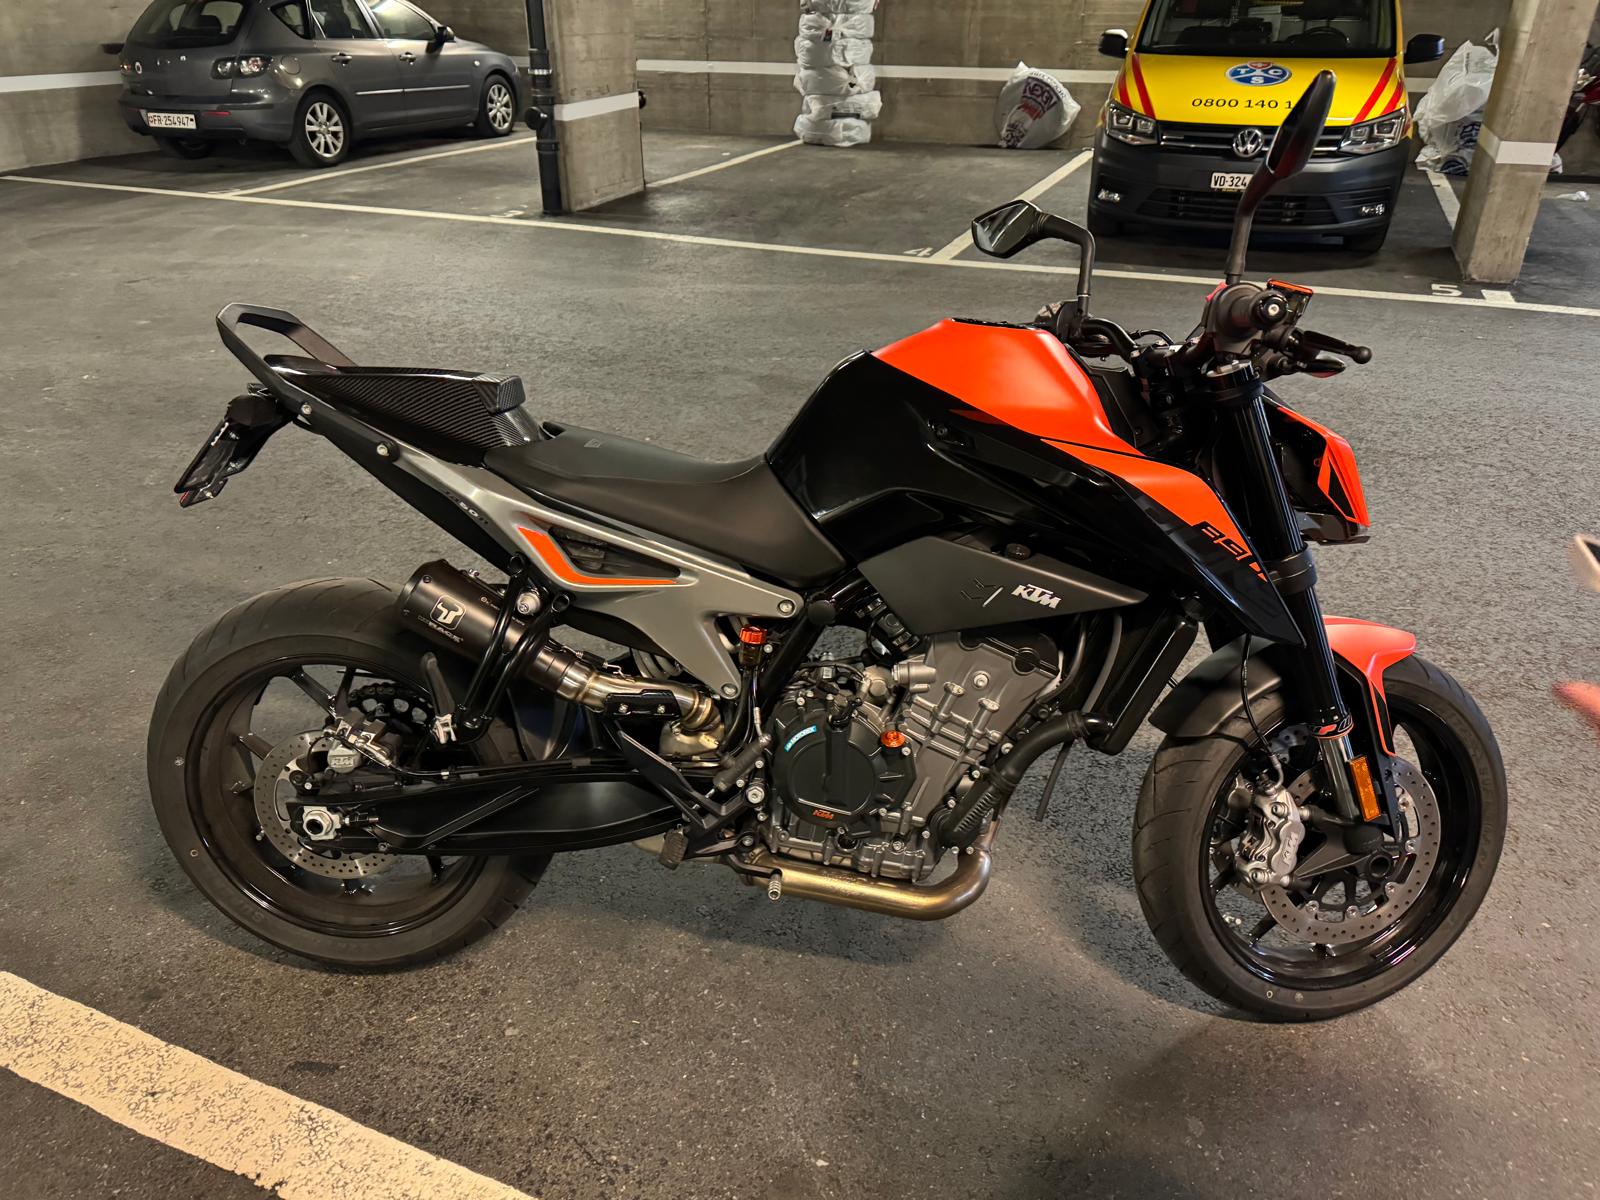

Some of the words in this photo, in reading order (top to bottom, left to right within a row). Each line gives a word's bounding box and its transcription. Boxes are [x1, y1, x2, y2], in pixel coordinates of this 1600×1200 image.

[1191, 98, 1239, 108] 0800
[1244, 99, 1278, 109] 140
[903, 247, 933, 257] 4
[1430, 283, 1462, 297] 5
[1011, 583, 1061, 609] KTM
[331, 756, 354, 768] KTM
[813, 809, 834, 820] KTM
